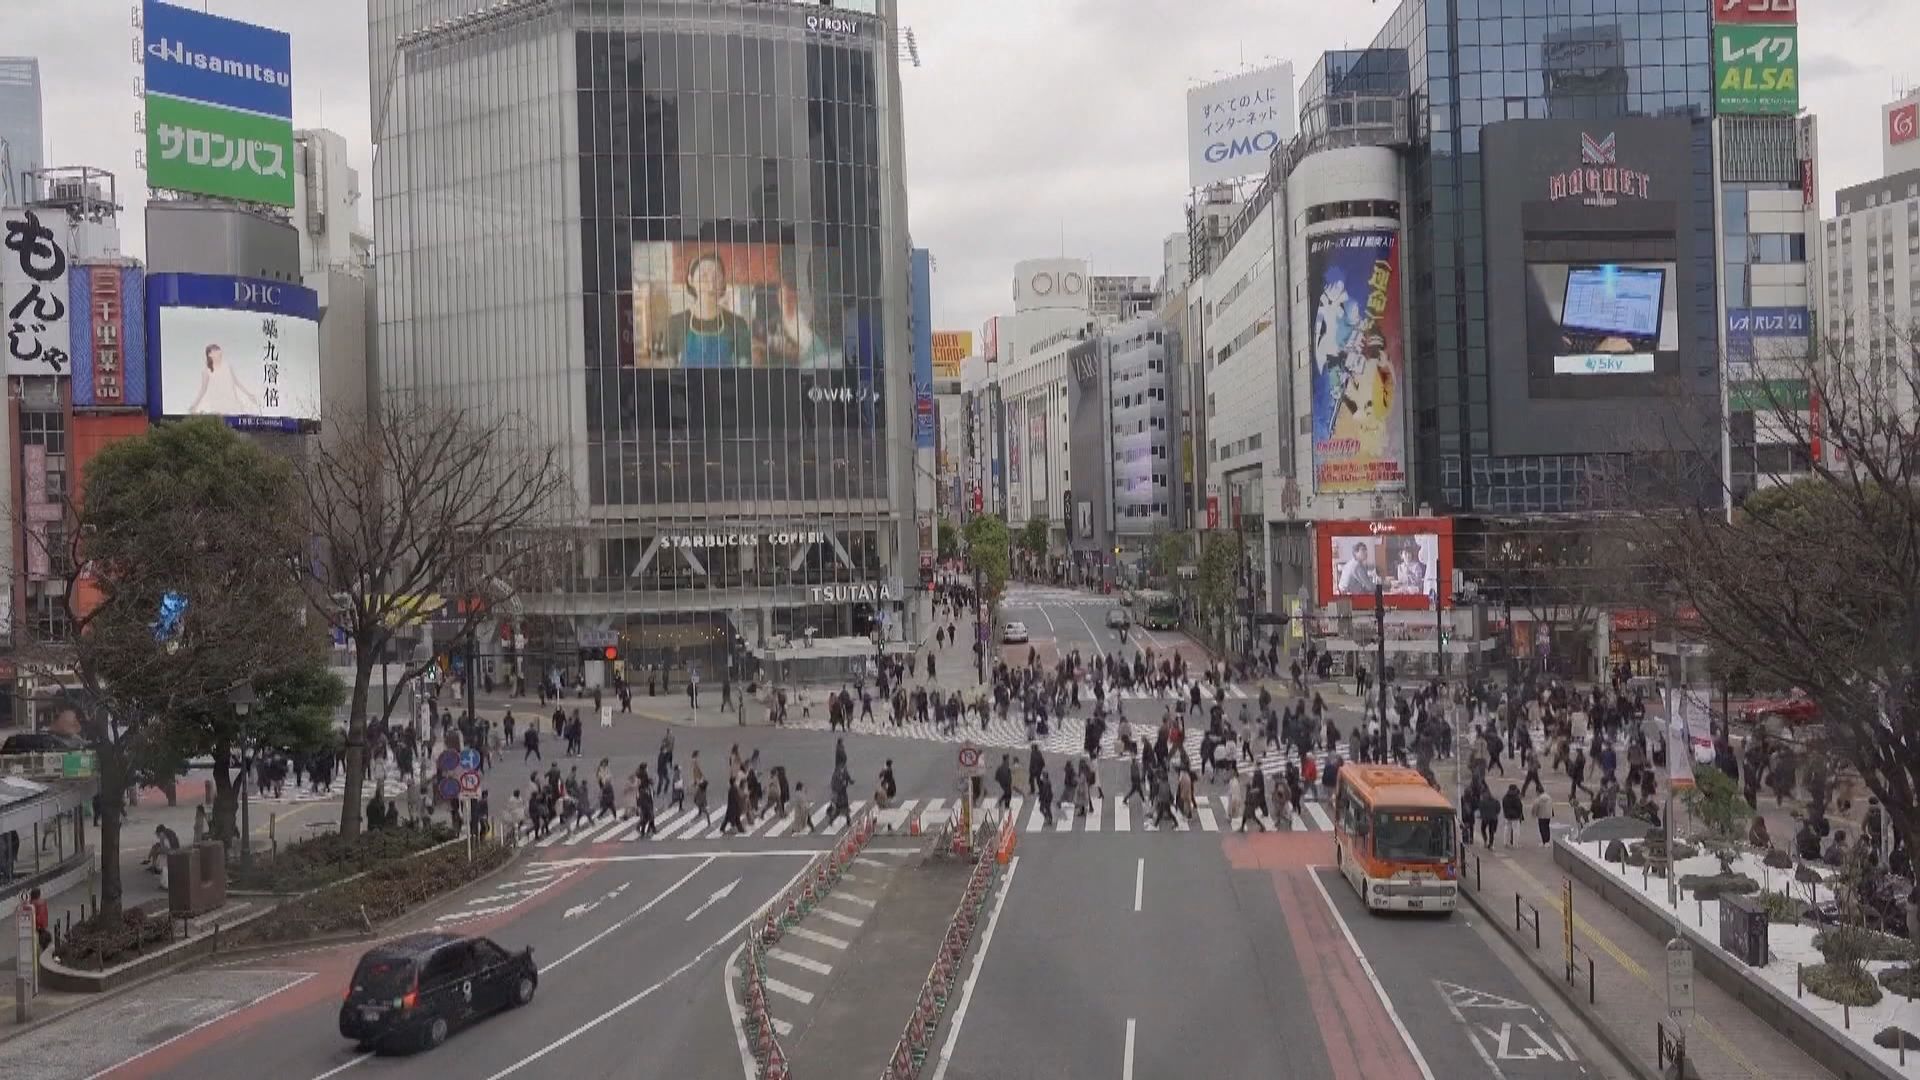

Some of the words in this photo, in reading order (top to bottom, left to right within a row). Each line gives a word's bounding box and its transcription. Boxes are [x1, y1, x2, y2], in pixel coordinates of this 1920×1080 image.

[148, 37, 290, 87] Hisamitsu
[1722, 36, 1793, 63] レイク
[1721, 67, 1794, 91] ALSA
[1203, 88, 1277, 119] すべての人に
[1204, 106, 1278, 136] インターネット
[157, 123, 286, 179] サロンパス
[1204, 130, 1278, 163] GMO
[1550, 167, 1650, 200] MAGNET
[5, 210, 69, 373] もんじゃ
[234, 282, 281, 305] DHC
[661, 533, 758, 548] STARBUCKS
[768, 532, 825, 546] COFFEE
[811, 584, 891, 602] TSUTAYA
